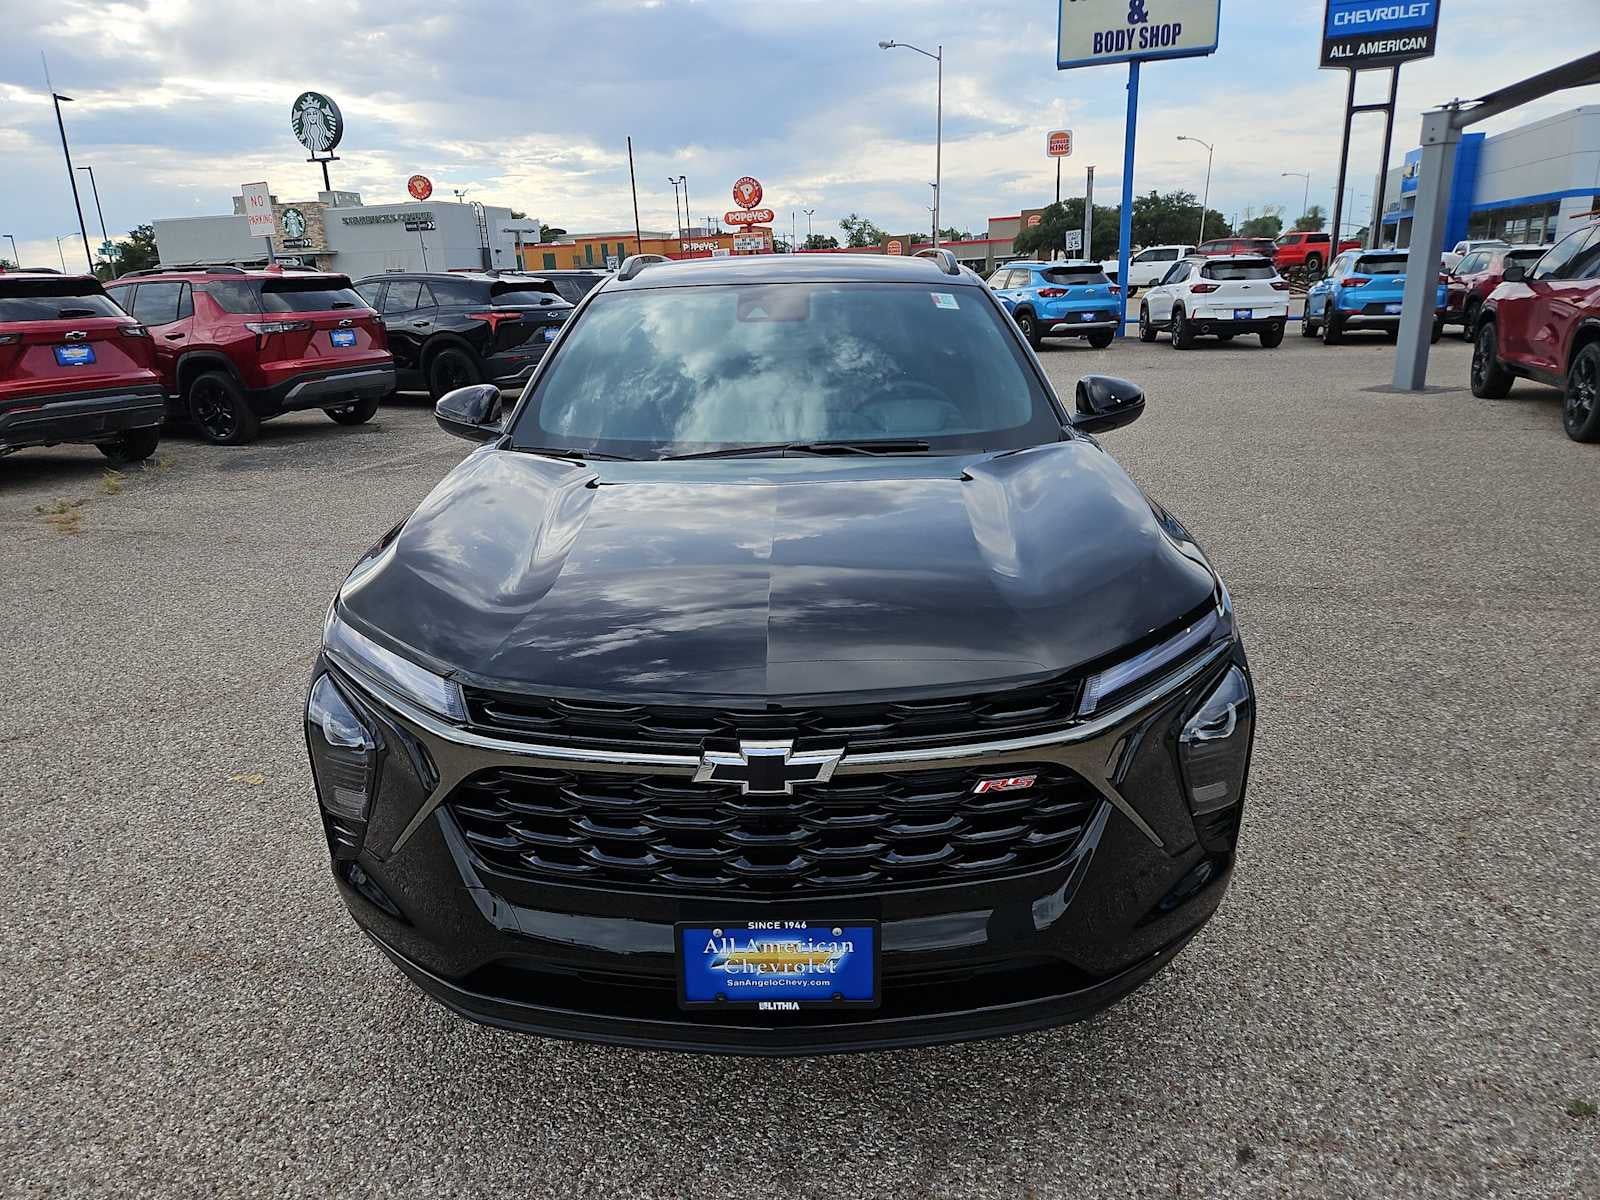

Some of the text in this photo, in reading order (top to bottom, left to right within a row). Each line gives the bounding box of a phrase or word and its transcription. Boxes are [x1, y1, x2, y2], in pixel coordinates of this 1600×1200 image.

[1127, 0, 1149, 25] &
[1333, 3, 1430, 26] CHEVROLET
[1093, 23, 1182, 54] BODY SHOP
[1329, 36, 1427, 58] ALL AMERICAN
[1049, 144, 1070, 152] KING
[250, 195, 264, 207] NO
[248, 215, 273, 225] PARKING
[1068, 240, 1080, 249] 35
[973, 775, 1038, 794] RS
[747, 921, 807, 930] SINCE 1946
[703, 937, 855, 954] All American
[723, 957, 837, 975] Chevrolet
[726, 978, 831, 988] SanAngeloChevy.com
[767, 1001, 800, 1011] LITHIA
